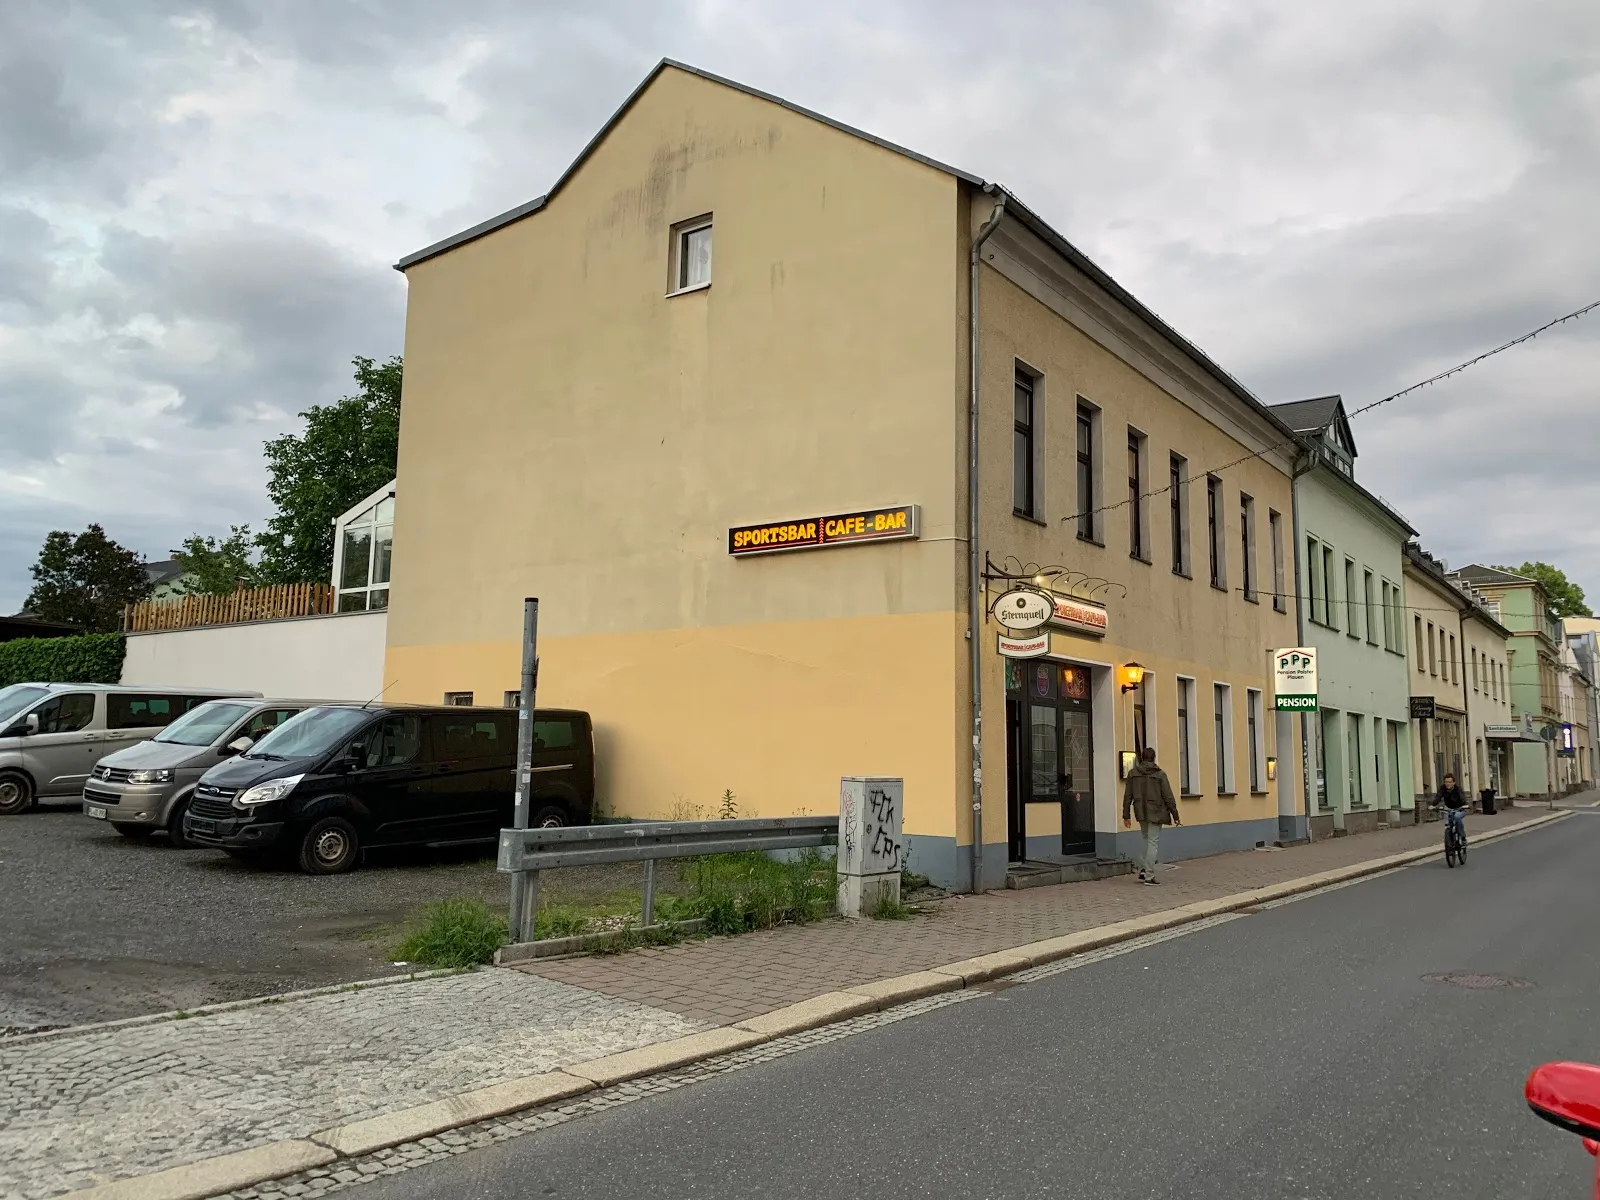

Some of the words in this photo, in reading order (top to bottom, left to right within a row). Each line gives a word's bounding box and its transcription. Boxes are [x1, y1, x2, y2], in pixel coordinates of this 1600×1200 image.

[734, 523, 816, 547] SPORTSBAR
[1001, 608, 1044, 622] Sternquell
[1277, 698, 1315, 707] PENSION
